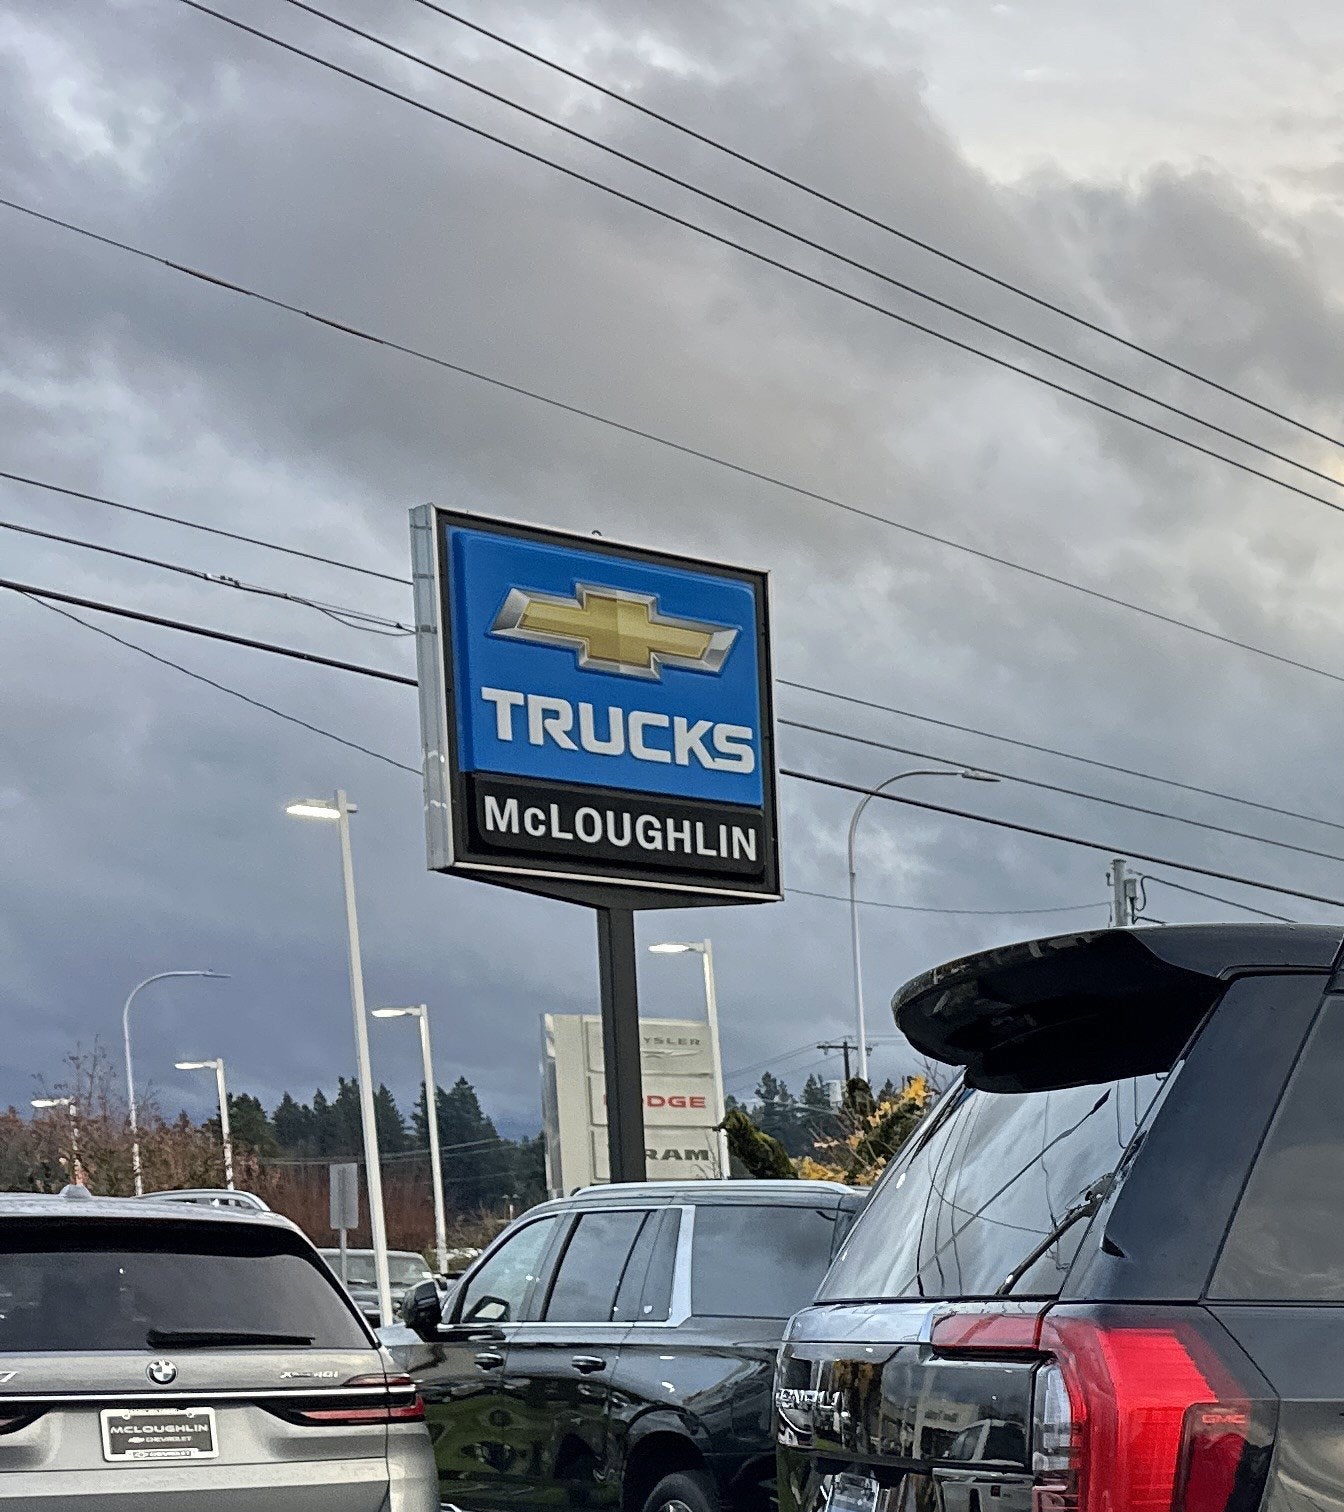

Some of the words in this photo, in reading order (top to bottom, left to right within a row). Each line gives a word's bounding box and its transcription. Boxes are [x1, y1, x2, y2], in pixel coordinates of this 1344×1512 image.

[481, 686, 755, 774] TRUCKS
[484, 795, 757, 861] McLOUGHLIN
[643, 1037, 700, 1046] YSLER
[603, 1095, 706, 1109] DGE
[644, 1148, 709, 1161] RAM
[1202, 1414, 1246, 1424] GMC
[110, 1424, 209, 1434] MCLOUGHLIN
